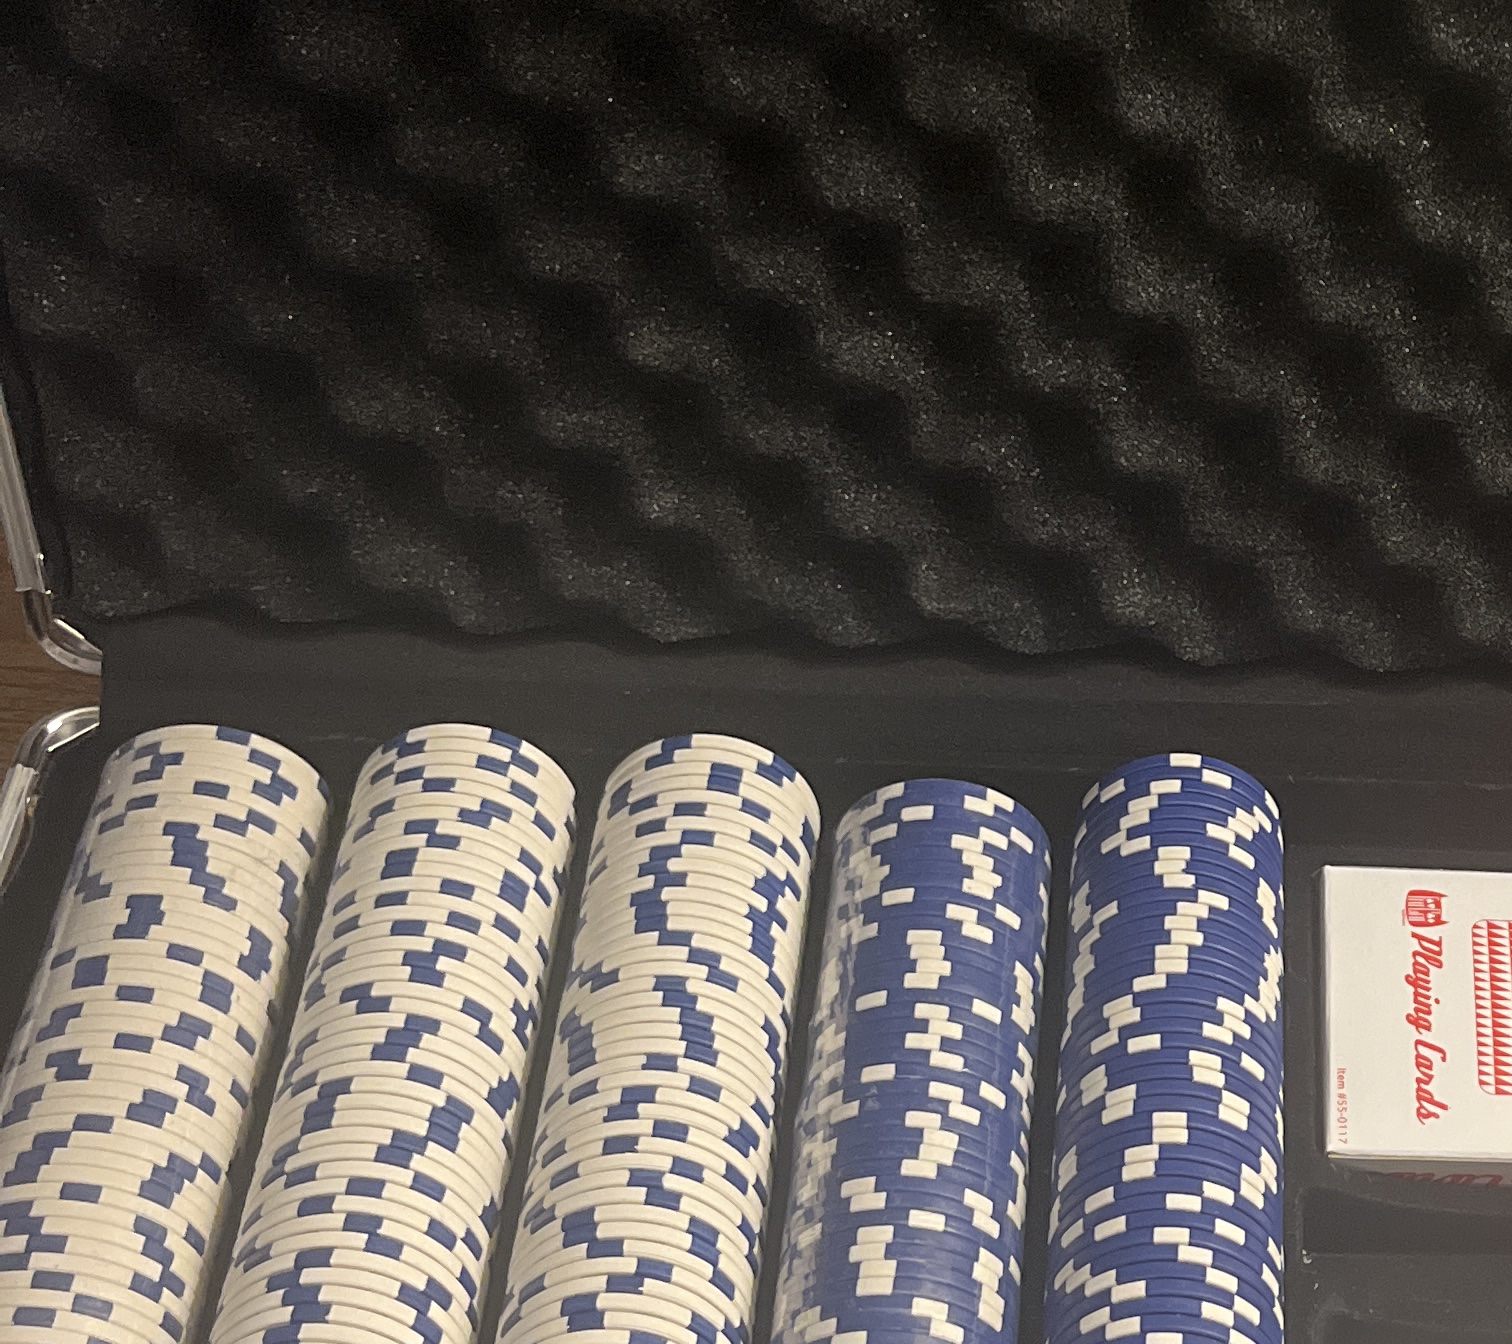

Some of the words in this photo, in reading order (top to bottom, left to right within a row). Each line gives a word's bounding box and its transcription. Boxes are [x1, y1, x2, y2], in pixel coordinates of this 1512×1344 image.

[1405, 931, 1443, 1035] Playing
[1336, 1068, 1347, 1089] Item
[1414, 1039, 1448, 1126] Cards
[1337, 1093, 1348, 1144] #55-0117
